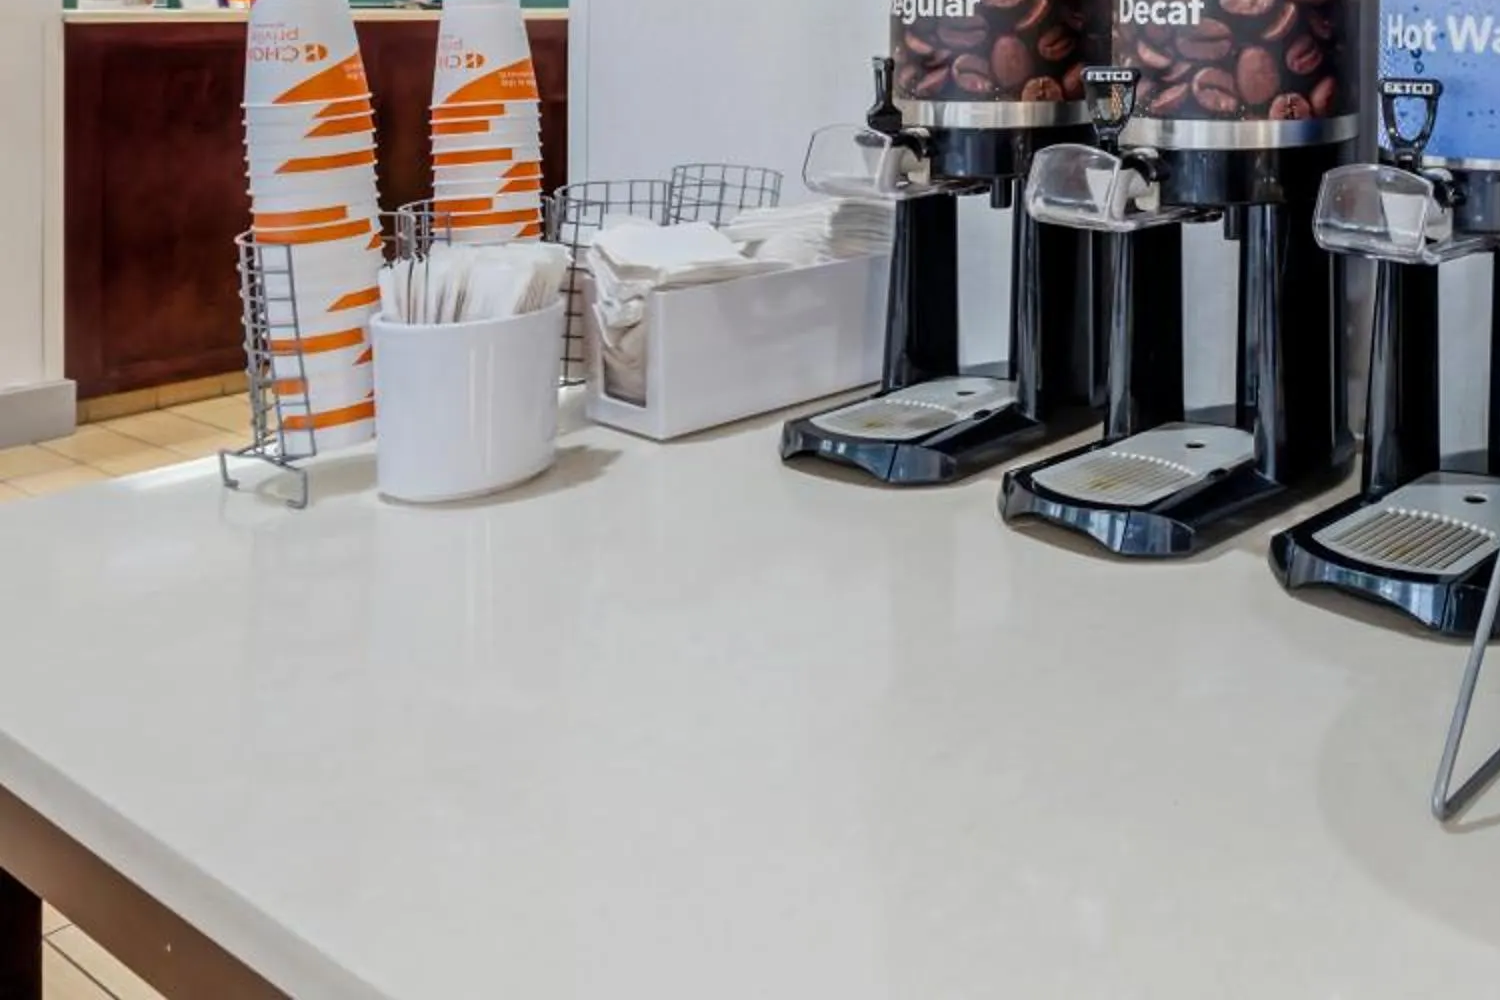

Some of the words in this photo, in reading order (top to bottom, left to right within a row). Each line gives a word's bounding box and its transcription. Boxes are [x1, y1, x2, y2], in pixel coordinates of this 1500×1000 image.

[1387, 13, 1437, 52] Hot
[1086, 70, 1134, 82] FETCO
[1383, 81, 1434, 95] FETCO
